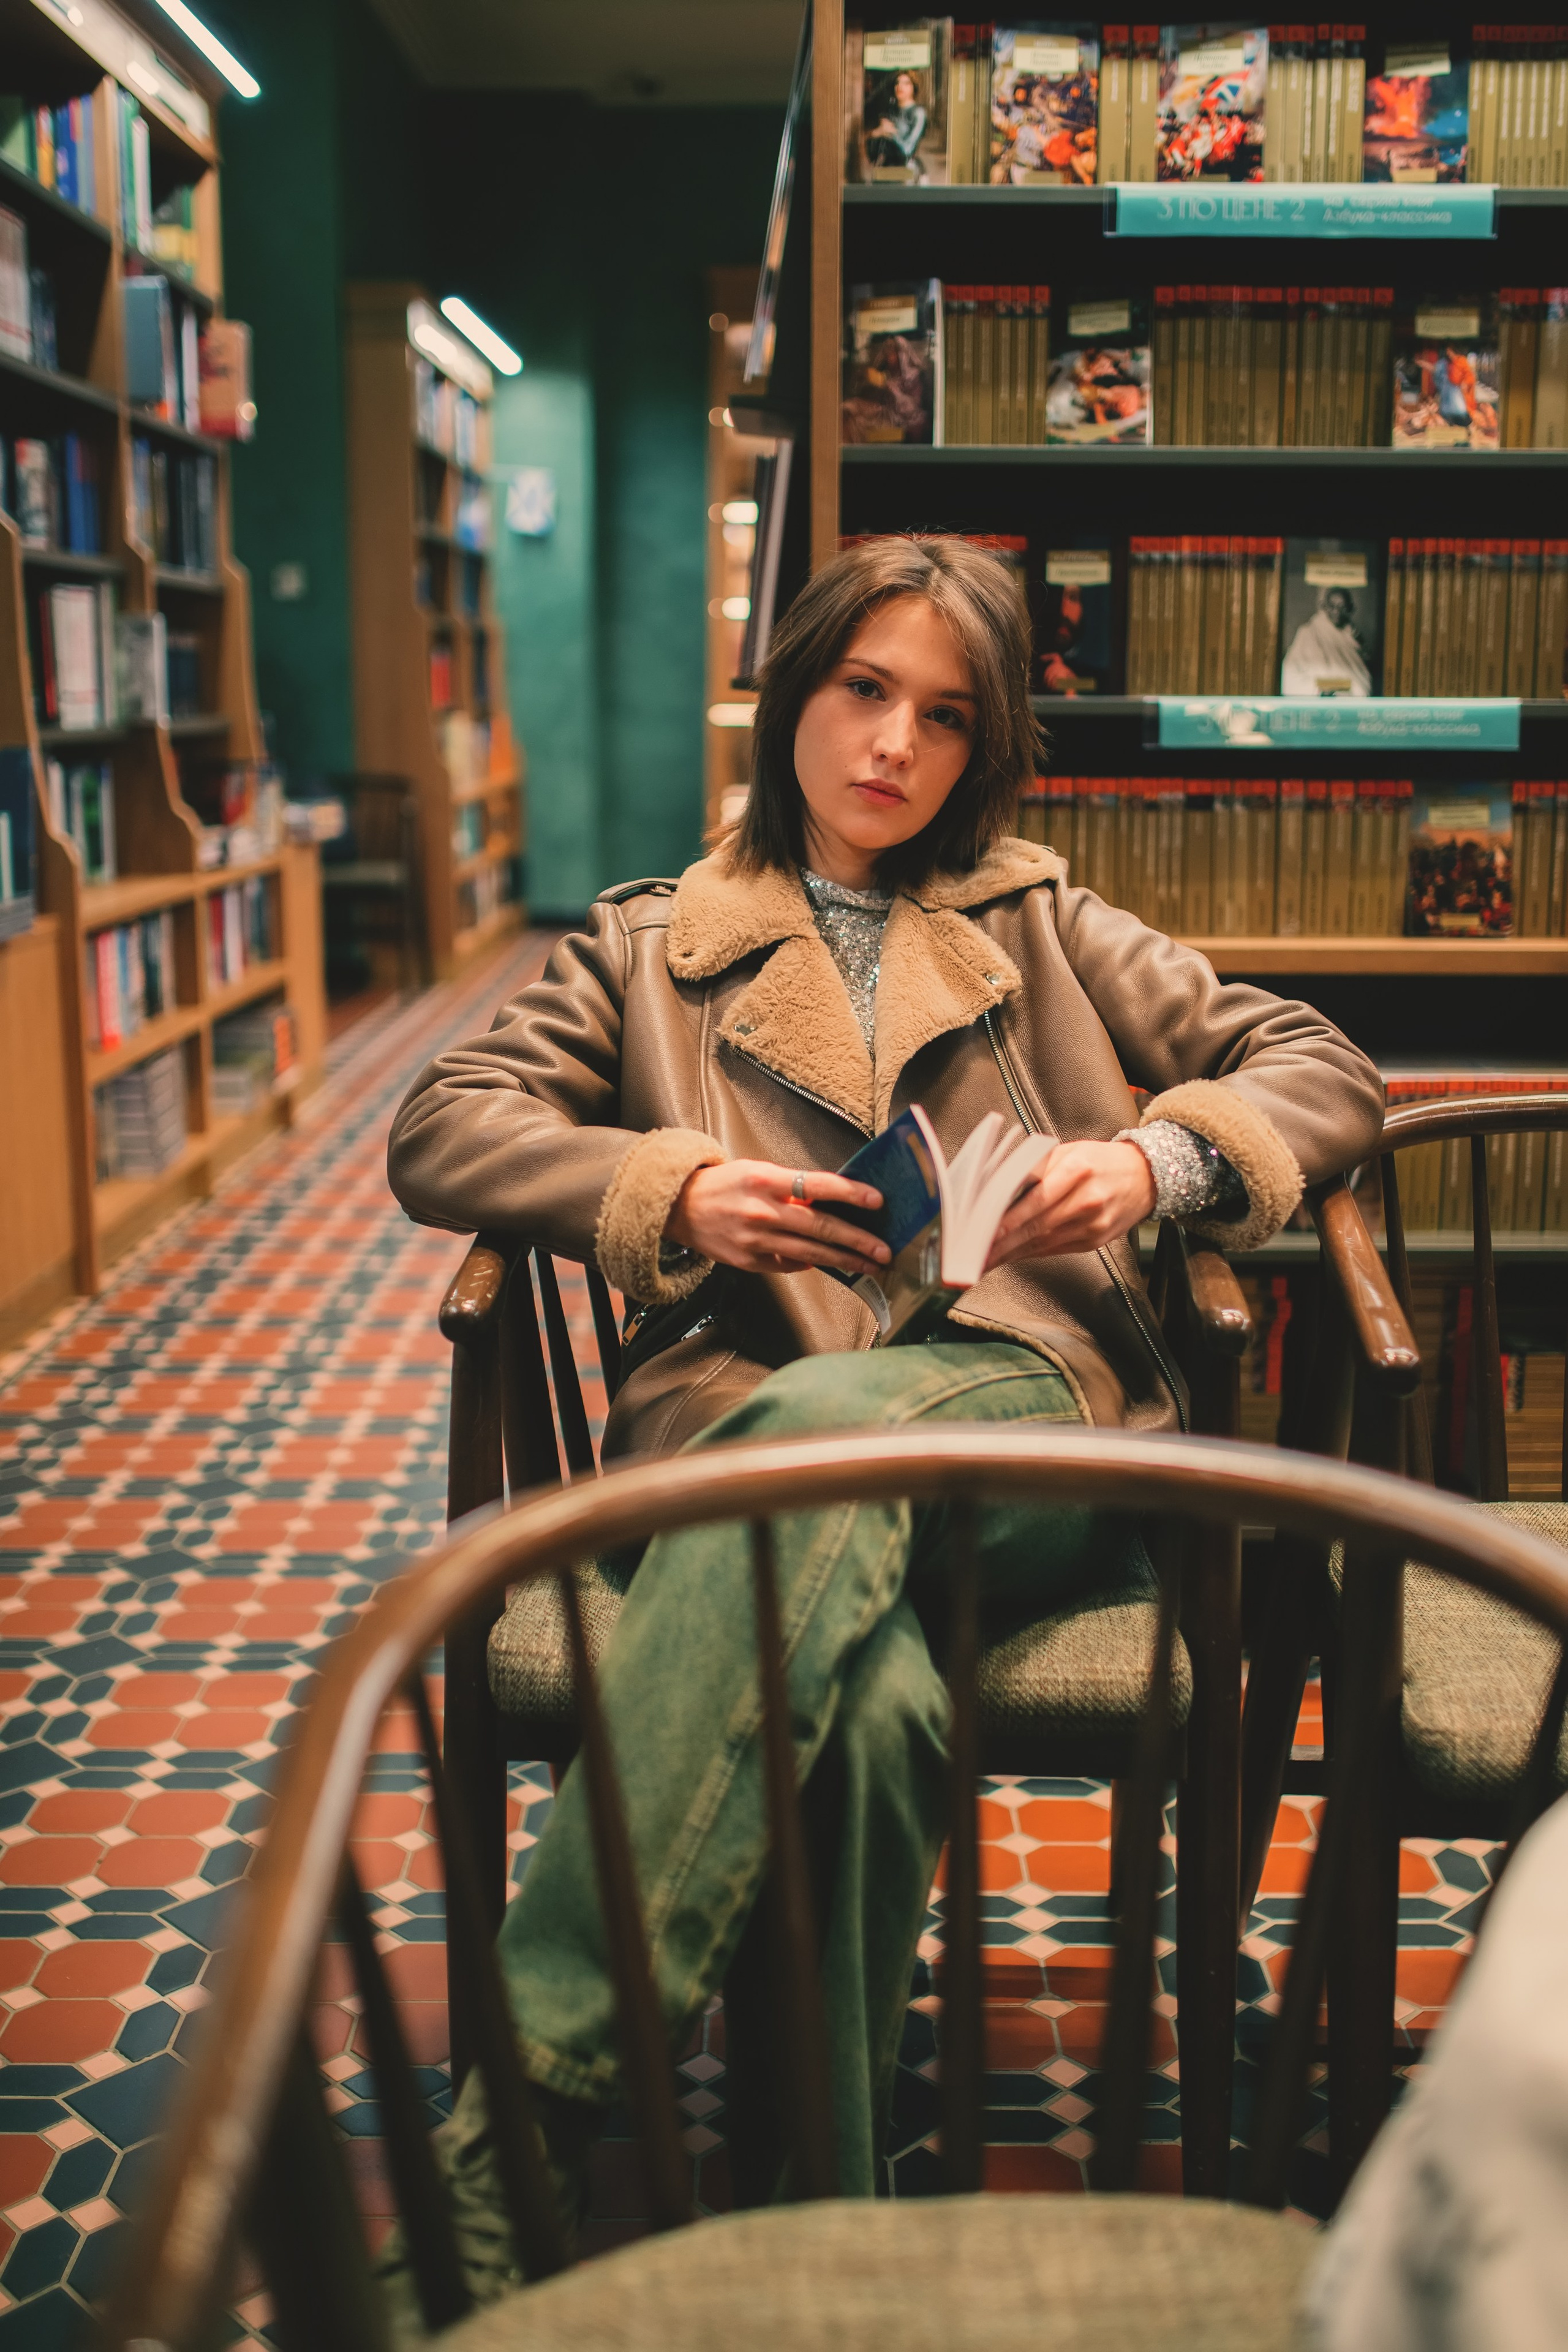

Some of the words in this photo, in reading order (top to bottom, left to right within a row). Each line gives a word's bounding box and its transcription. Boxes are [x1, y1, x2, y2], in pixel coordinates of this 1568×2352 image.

[1156, 195, 1174, 221] 3
[1178, 195, 1218, 221] ПО
[1222, 195, 1284, 223] ЦЕНЕ
[1289, 195, 1306, 221] 2
[1324, 709, 1341, 734] 2
